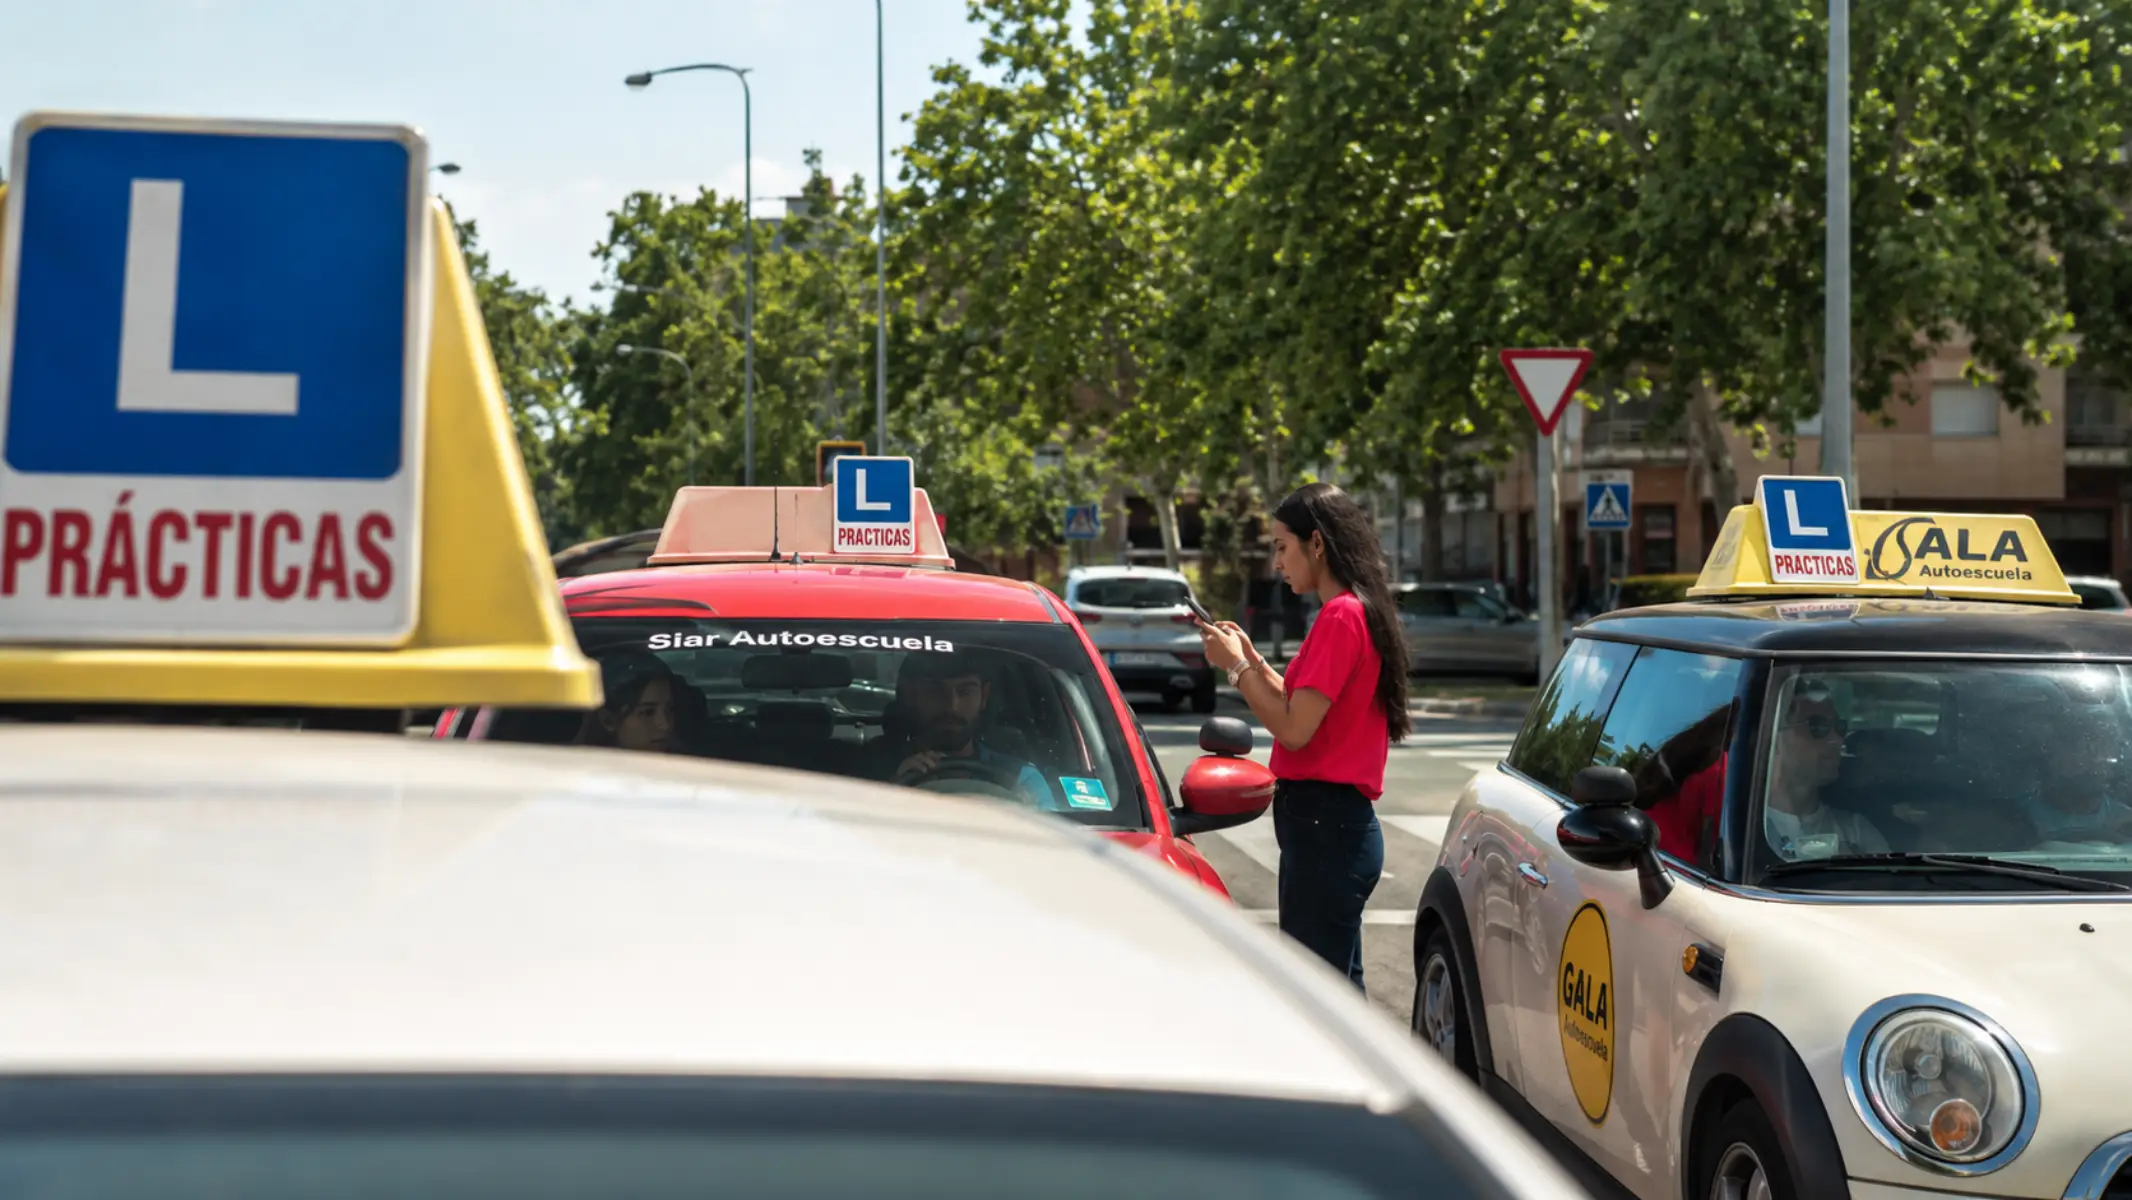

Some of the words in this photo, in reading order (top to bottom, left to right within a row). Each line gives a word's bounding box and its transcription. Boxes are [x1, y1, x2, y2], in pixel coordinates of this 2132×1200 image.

[117, 178, 299, 415] L
[856, 468, 891, 511] L
[1783, 489, 1829, 536] L
[0, 489, 395, 601] PRÁCTICAS
[838, 527, 911, 546] PRACTICAS
[1774, 554, 1855, 576] PRACTICAS
[1919, 564, 2032, 581] Autoescuela
[647, 632, 721, 650] Siar
[728, 630, 954, 652] Autoescuela
[1563, 961, 1608, 1031] GALA
